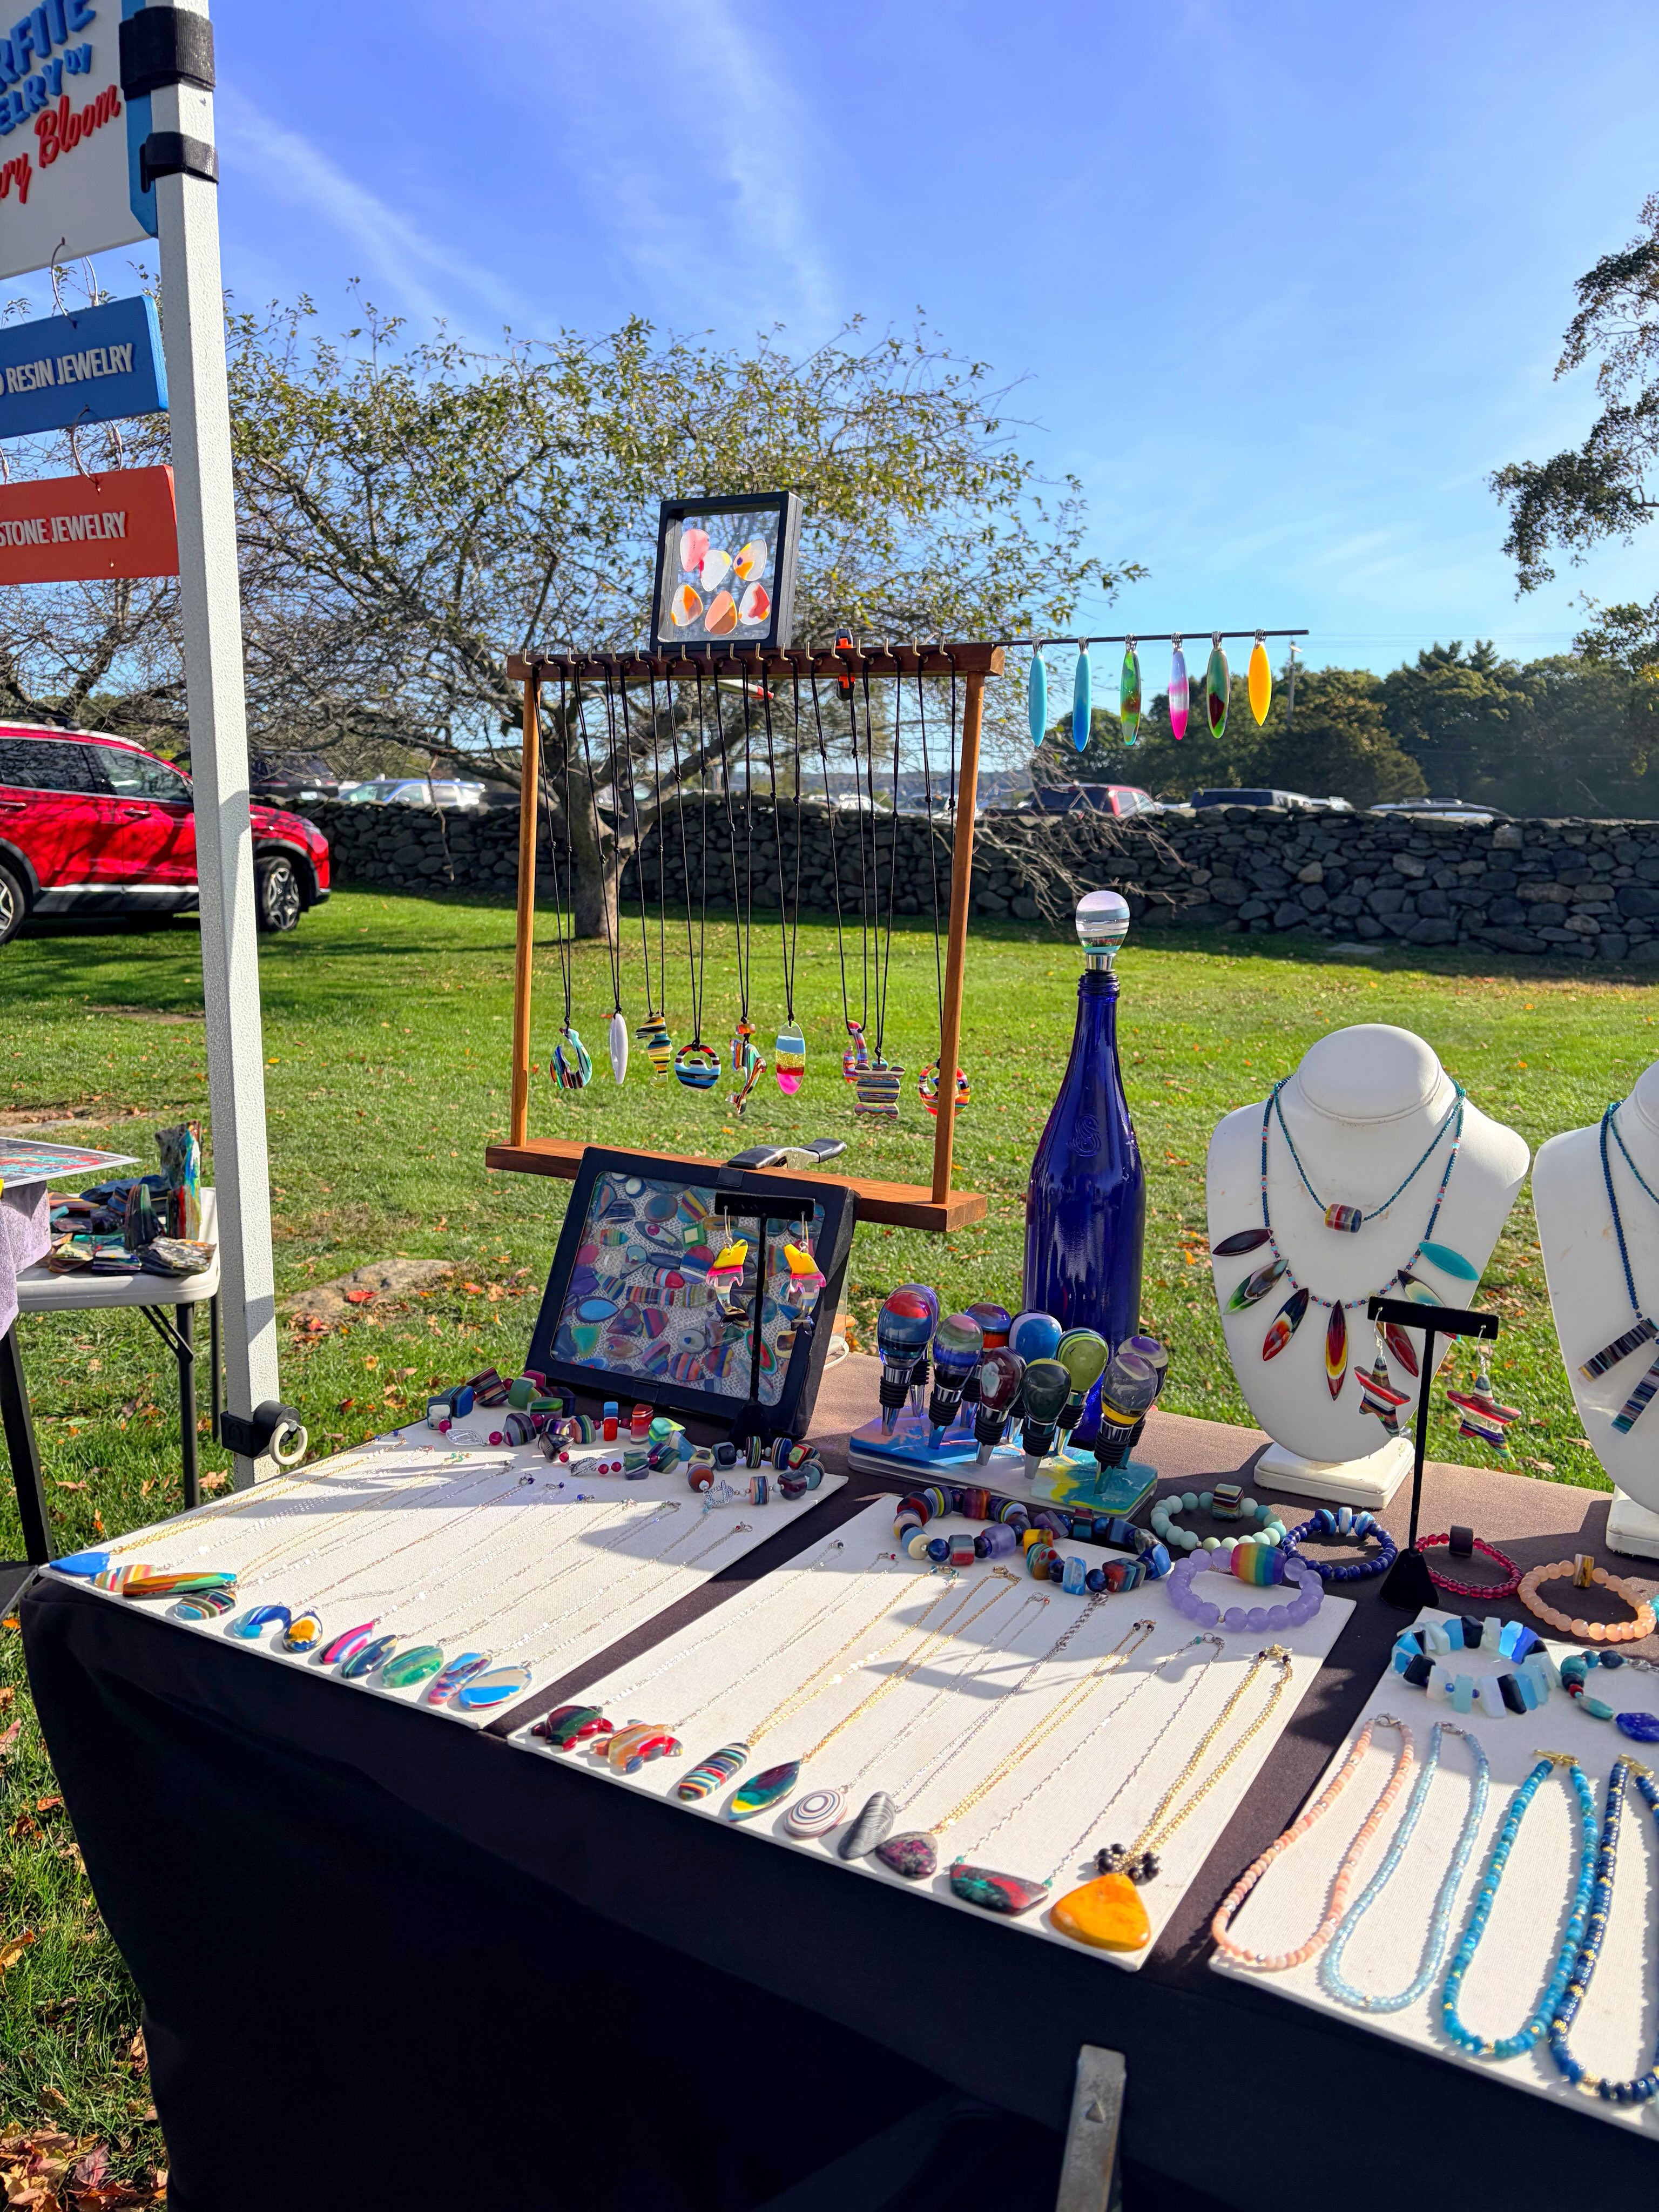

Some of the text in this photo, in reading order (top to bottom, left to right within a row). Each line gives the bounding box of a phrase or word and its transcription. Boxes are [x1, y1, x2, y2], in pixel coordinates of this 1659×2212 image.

[0, 84, 121, 204] ry Bloom
[6, 358, 55, 393] RESIN
[57, 343, 132, 385] JEWELRY
[51, 511, 126, 543] JEWELRY
